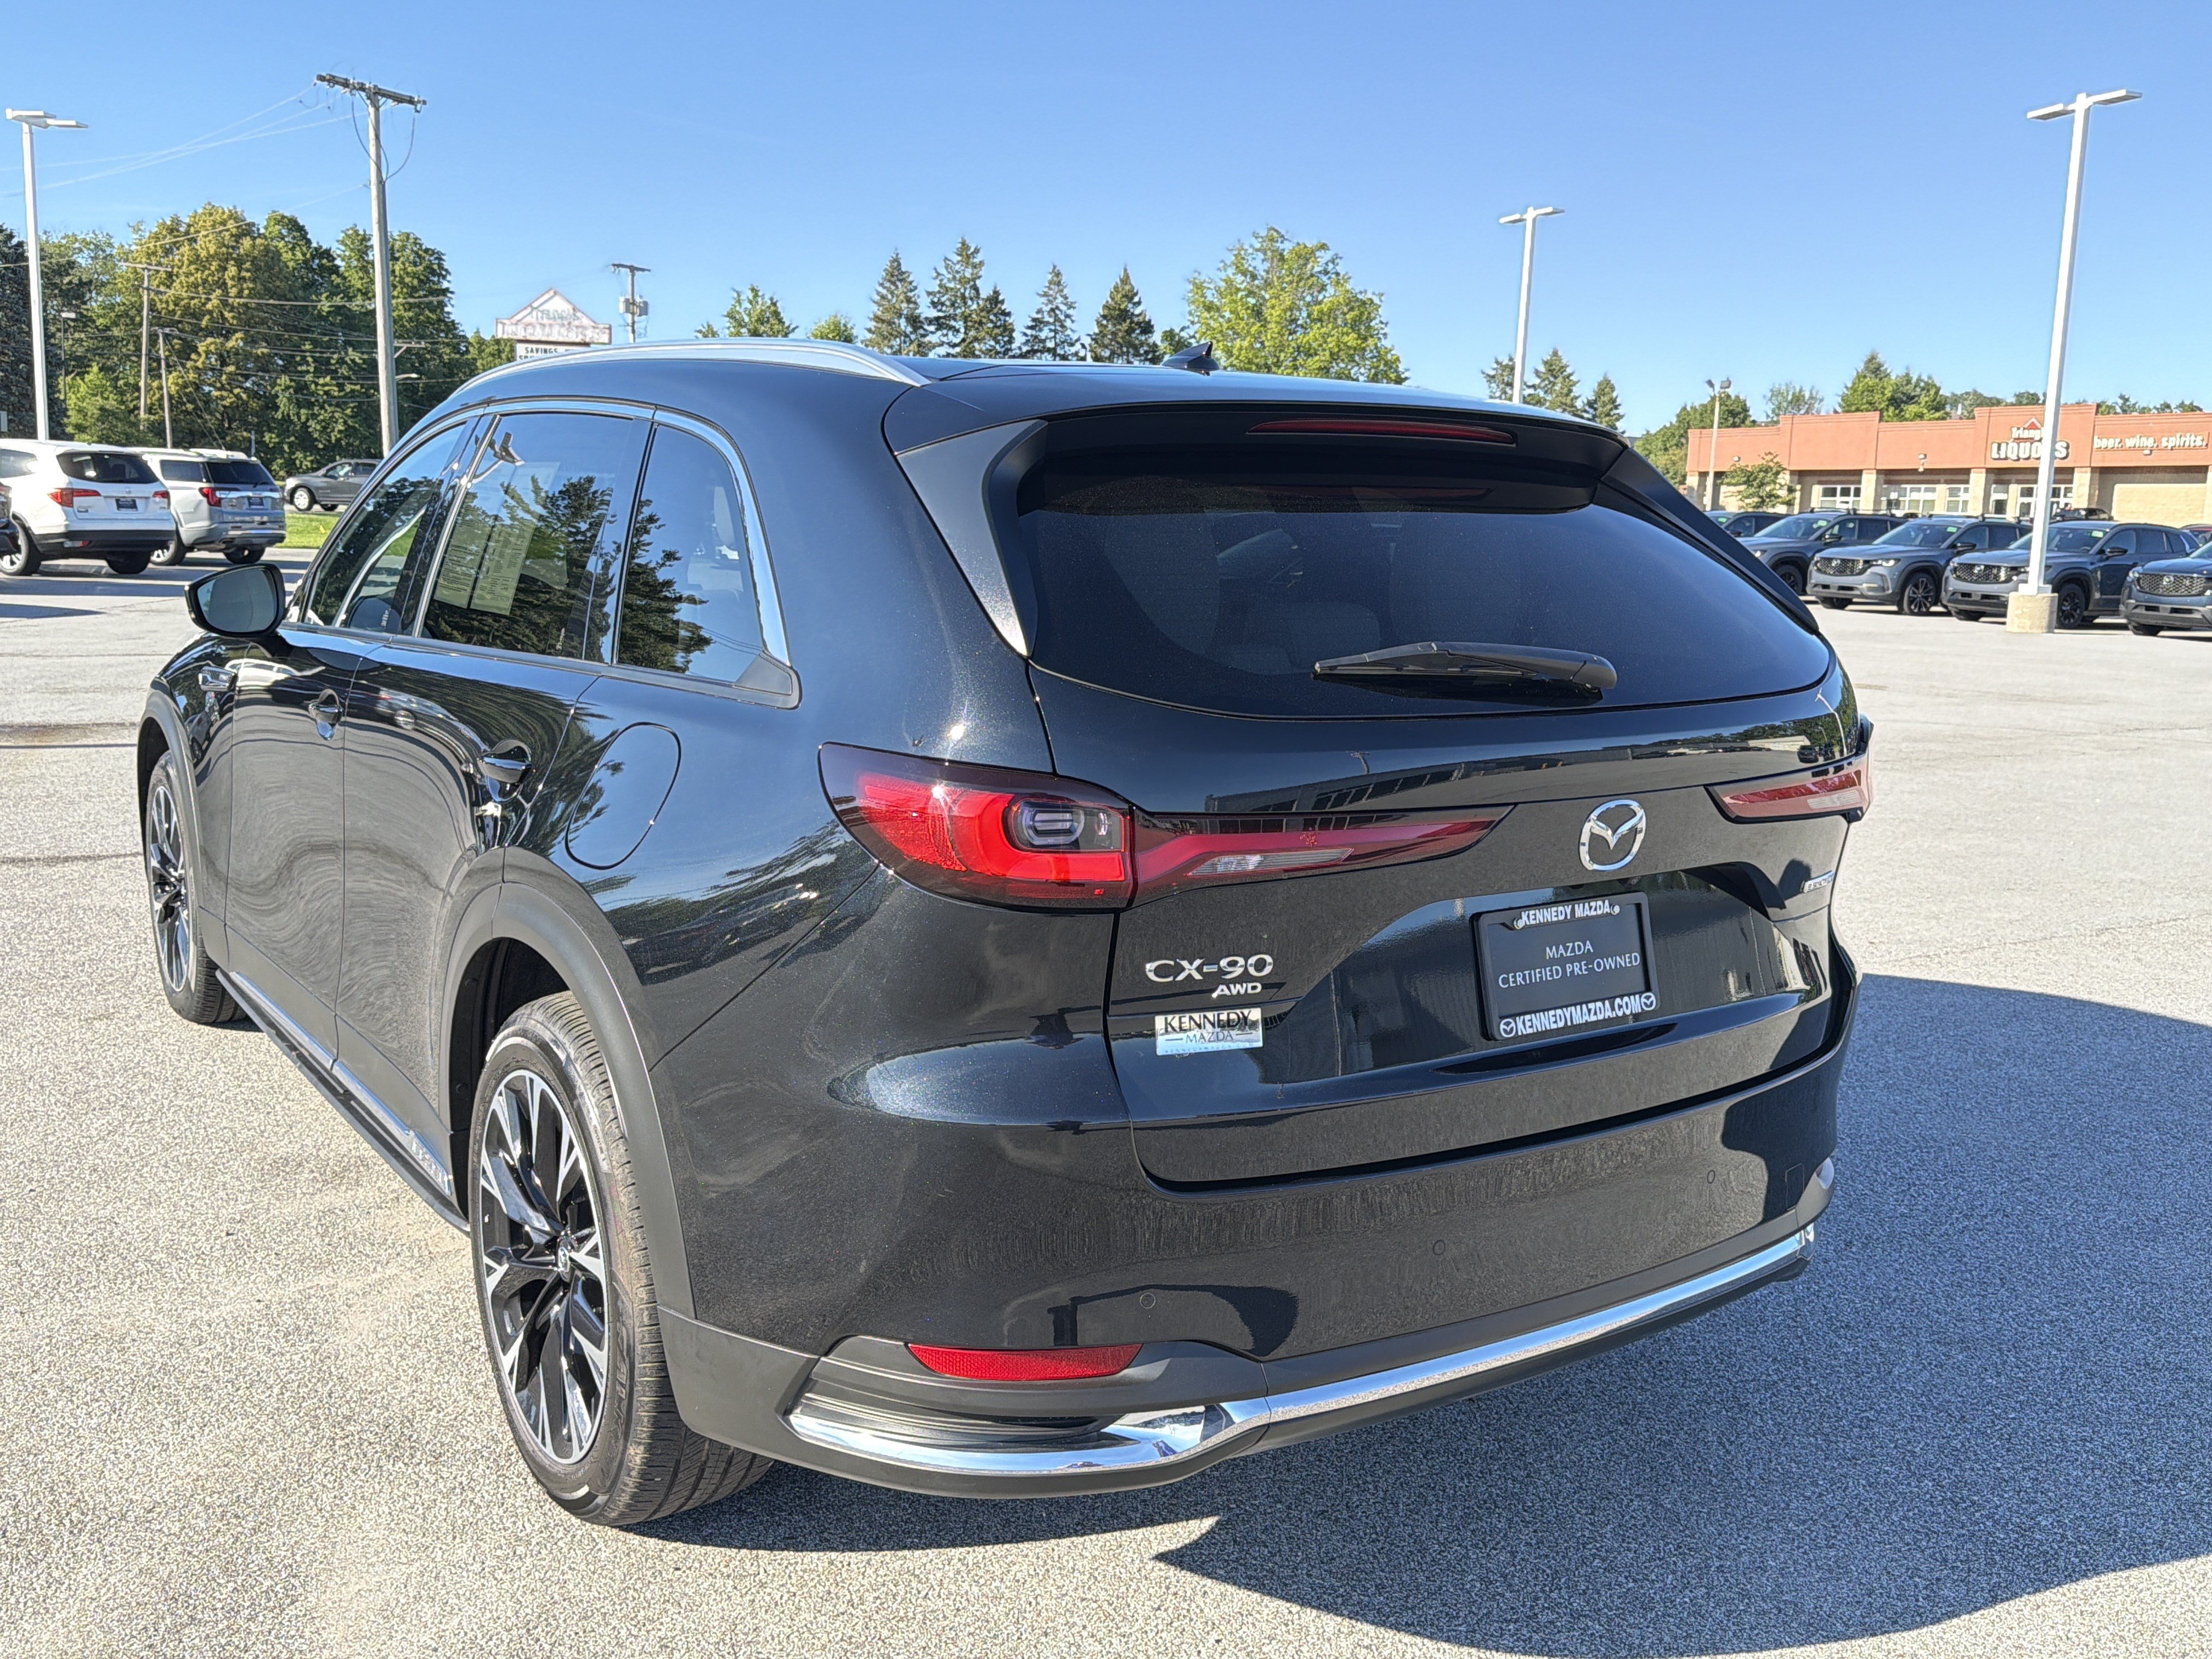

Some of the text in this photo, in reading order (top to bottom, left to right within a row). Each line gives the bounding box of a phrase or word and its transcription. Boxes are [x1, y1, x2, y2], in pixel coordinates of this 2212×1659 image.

[1991, 441, 2067, 460] LIQUOS
[1521, 899, 1611, 926] KENNEDY MAZDA
[1546, 940, 1594, 960] MAZDA
[1145, 954, 1273, 983] CX-90
[1498, 952, 1640, 988] CERTIFIED PRE-OWNED
[1211, 982, 1262, 998] AWD
[1164, 1010, 1252, 1033] KENNEDY
[1516, 995, 1642, 1035] KENNEDYMAZDA.COM
[1186, 1030, 1234, 1043] MAZDA
